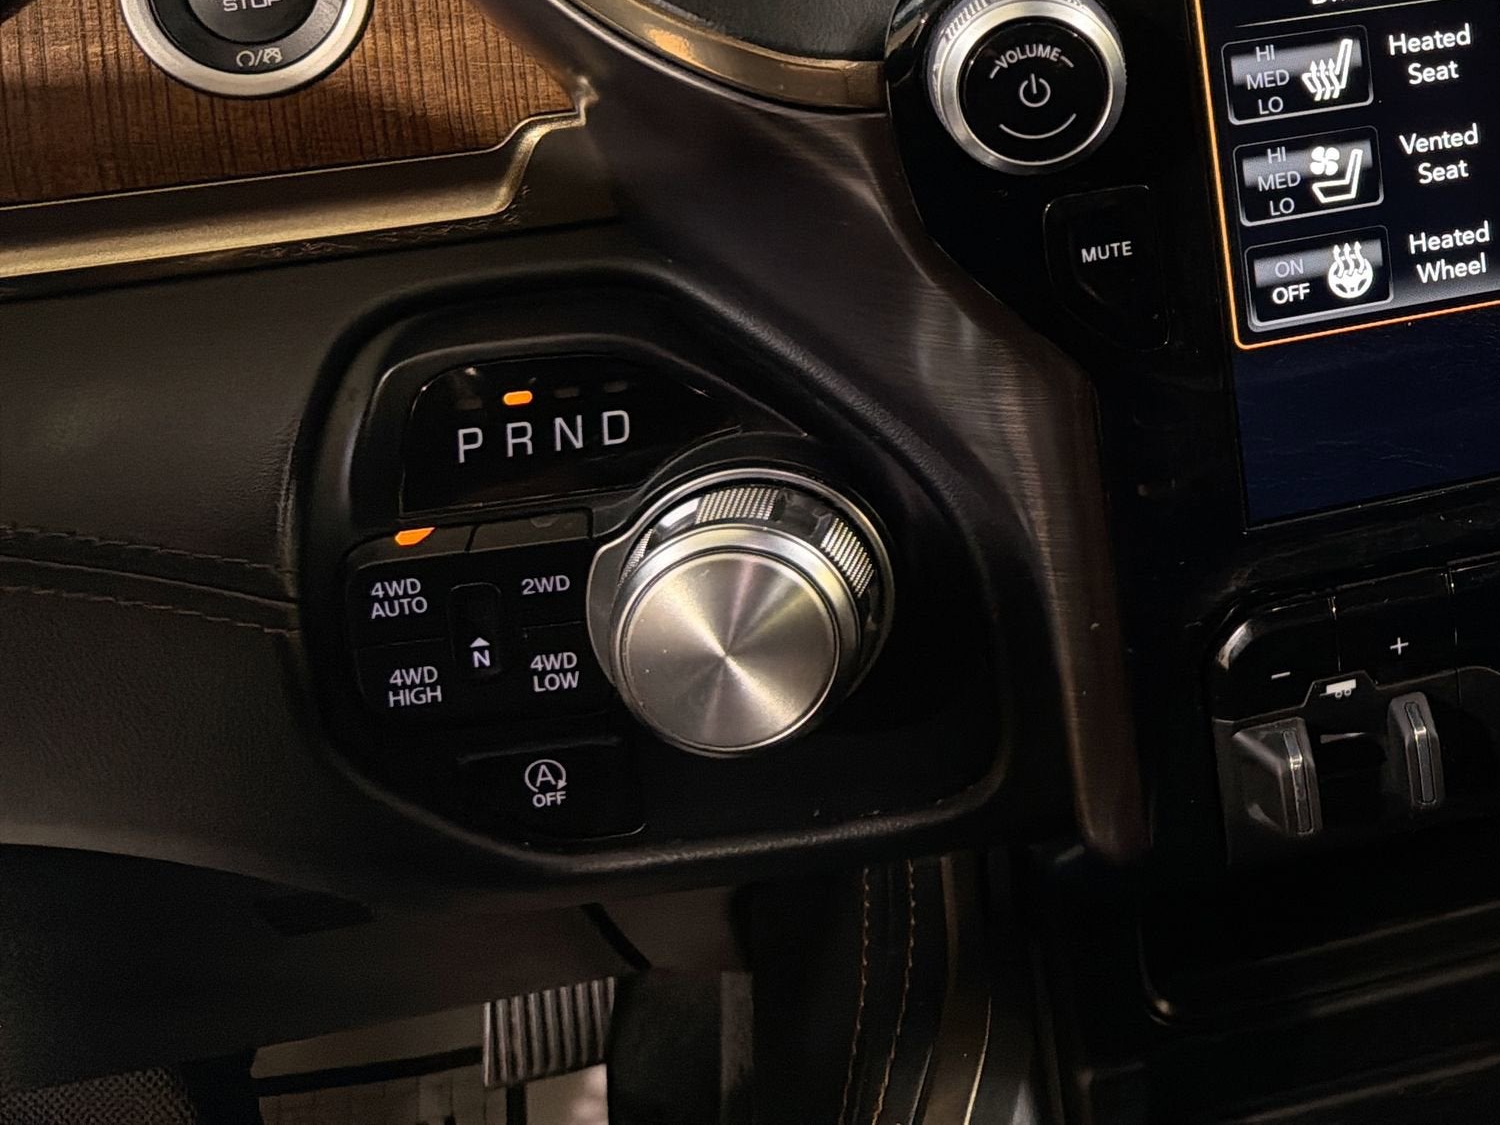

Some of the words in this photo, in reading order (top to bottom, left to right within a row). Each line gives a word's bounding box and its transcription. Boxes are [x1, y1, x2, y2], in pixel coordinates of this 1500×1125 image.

[1389, 24, 1471, 56] Heated
[996, 44, 1062, 70] VOLUME
[1255, 46, 1276, 63] HI
[1246, 69, 1289, 89] MED
[1408, 57, 1459, 85] Seat
[1258, 96, 1284, 114] LO
[1400, 124, 1479, 156] Vented
[1266, 147, 1288, 164] HI
[1257, 171, 1300, 191] MED
[1418, 157, 1469, 184] Seat
[1269, 197, 1295, 216] LO
[1409, 222, 1490, 255] Heated
[1081, 241, 1133, 263] MUTE
[1275, 259, 1304, 277] ON
[1416, 254, 1487, 283] Wheel
[1272, 283, 1310, 304] OFF
[457, 426, 484, 463] P
[506, 421, 534, 458] R
[553, 415, 583, 453] N
[601, 410, 631, 446] D
[371, 577, 422, 598] 4WD
[521, 575, 570, 595] 2WD
[370, 598, 428, 620] AUTO
[473, 650, 490, 668] N
[530, 652, 578, 673] 4WD
[389, 666, 438, 686] 4WD
[533, 671, 579, 693] LOW
[388, 685, 443, 709] HIGH
[532, 791, 567, 808] OFF
